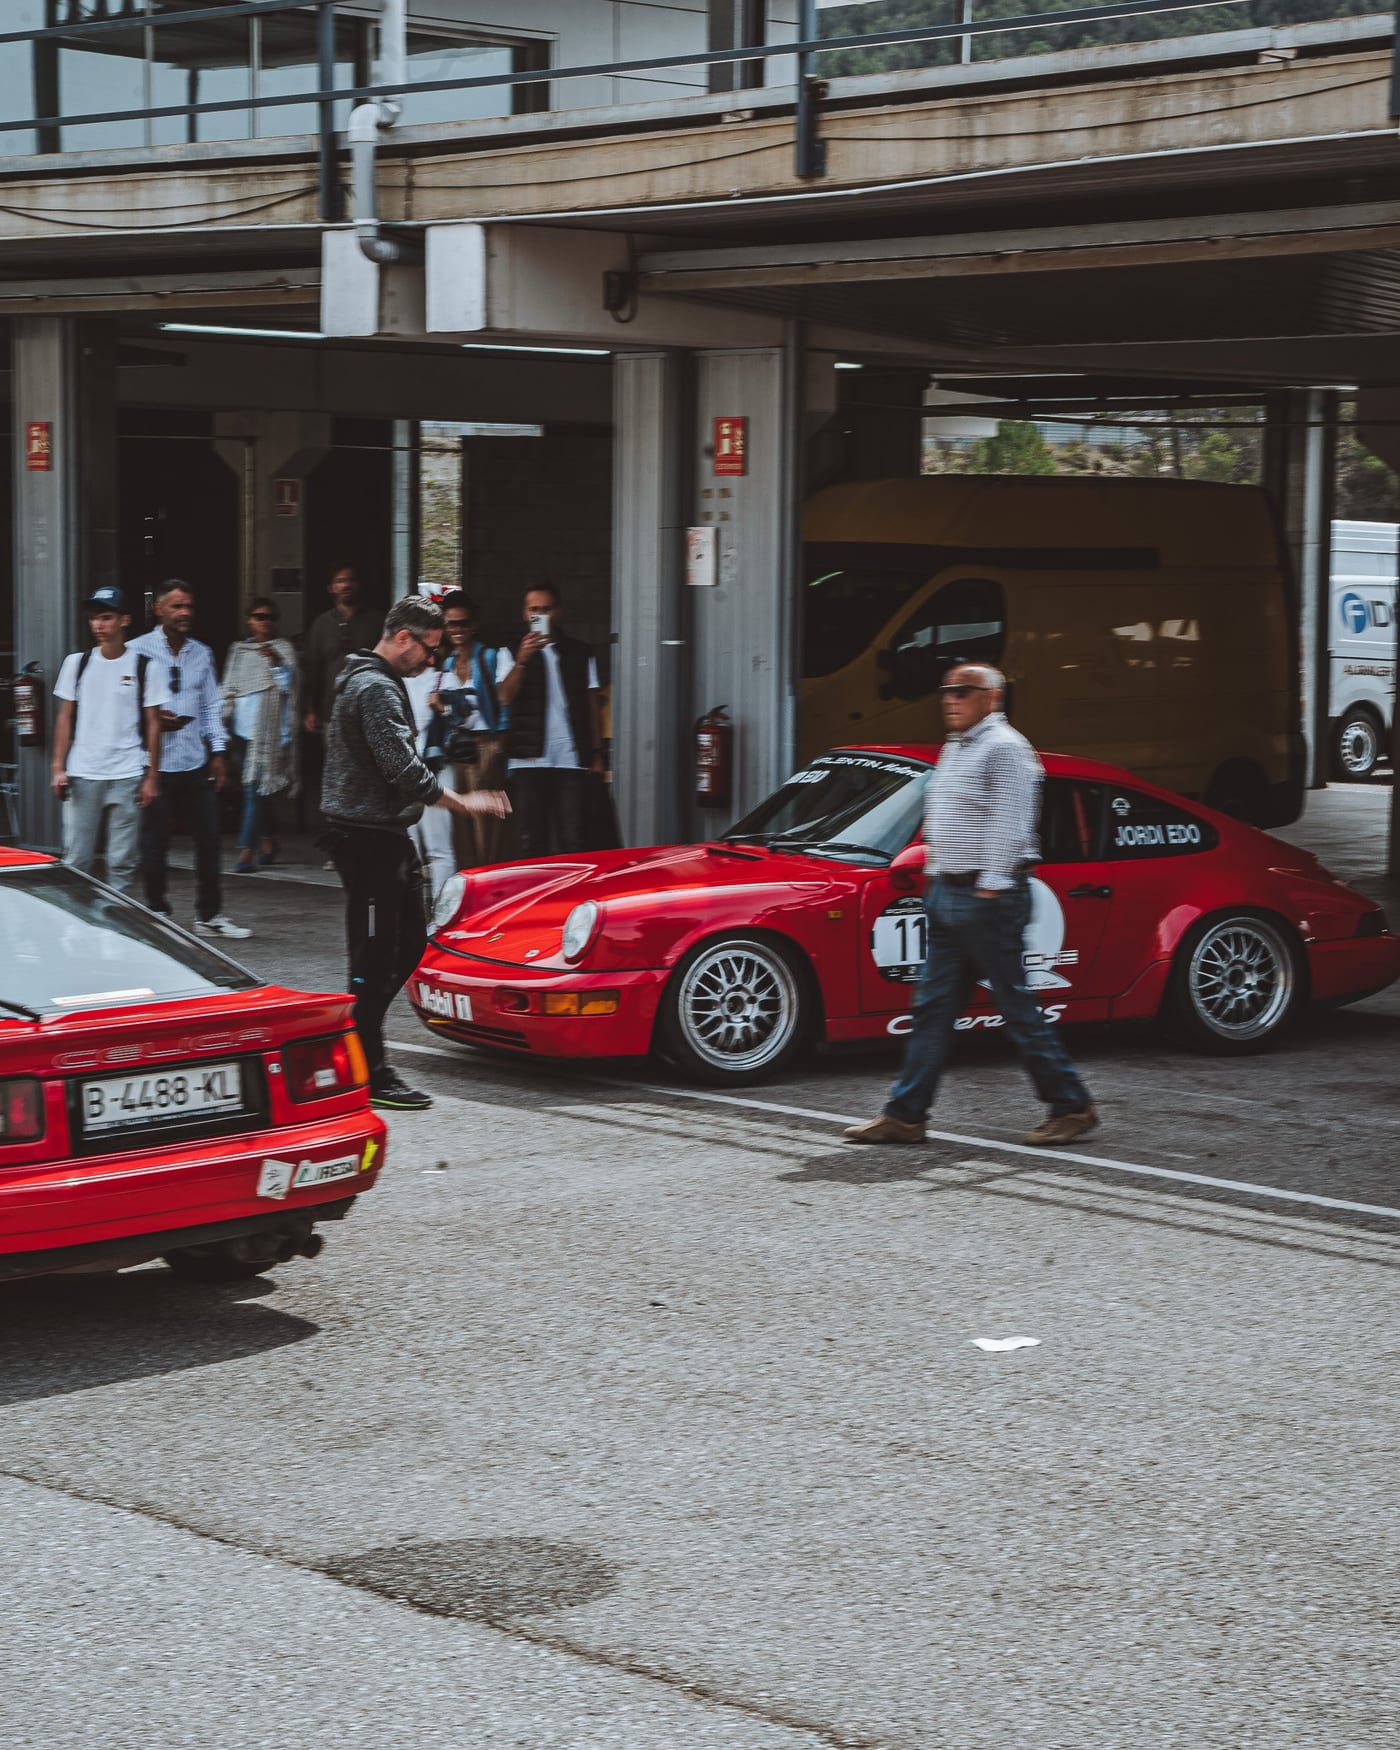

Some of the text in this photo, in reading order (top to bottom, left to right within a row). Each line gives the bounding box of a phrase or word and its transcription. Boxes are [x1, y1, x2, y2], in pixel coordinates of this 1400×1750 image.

[1115, 823, 1200, 846] JORDI EDO
[894, 916, 926, 961] 11
[886, 1004, 1068, 1034] Cera S
[54, 1028, 271, 1068] CELICA
[86, 1070, 240, 1119] B-4488-KL
